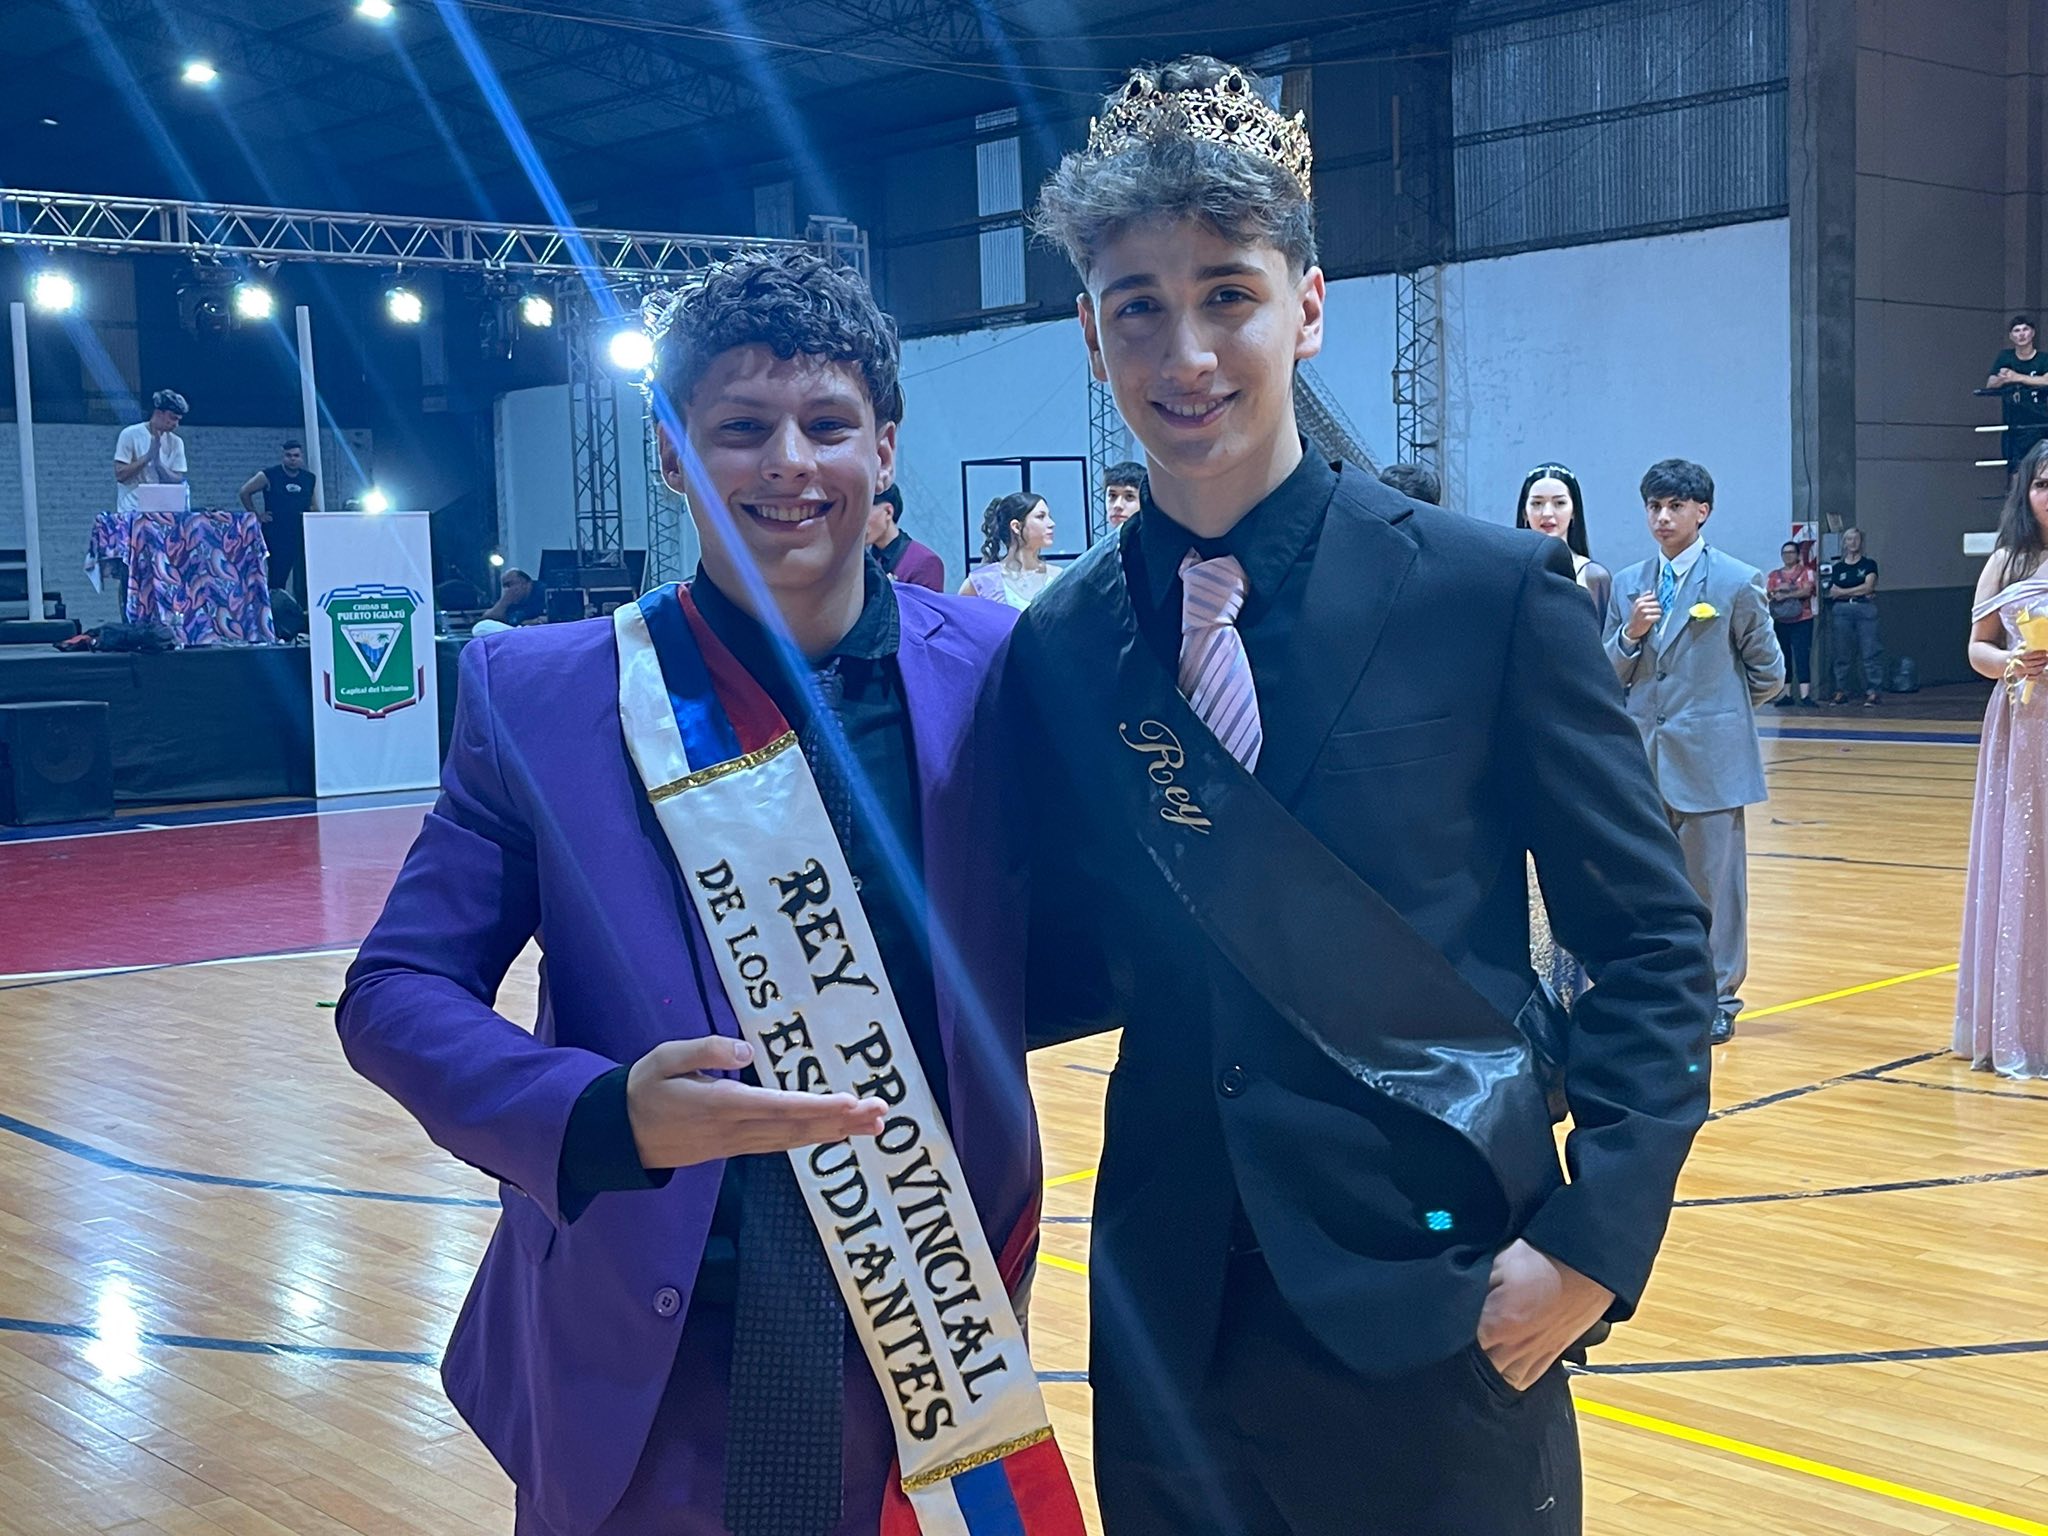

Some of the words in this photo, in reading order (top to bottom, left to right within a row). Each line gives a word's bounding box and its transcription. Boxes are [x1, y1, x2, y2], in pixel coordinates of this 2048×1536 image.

[337, 611, 371, 621] PUERTO
[373, 609, 406, 619] IGUAZÚ
[352, 603, 380, 611] CIUDAD
[340, 687, 367, 696] Capital
[381, 685, 409, 693] Turismo
[1118, 719, 1212, 835] Rey
[695, 857, 746, 926] DE
[725, 922, 784, 1010] LOS
[757, 1010, 957, 1442] ESUDIANTES
[769, 857, 879, 996] REY
[835, 1020, 1007, 1403] PROVINCIAL
